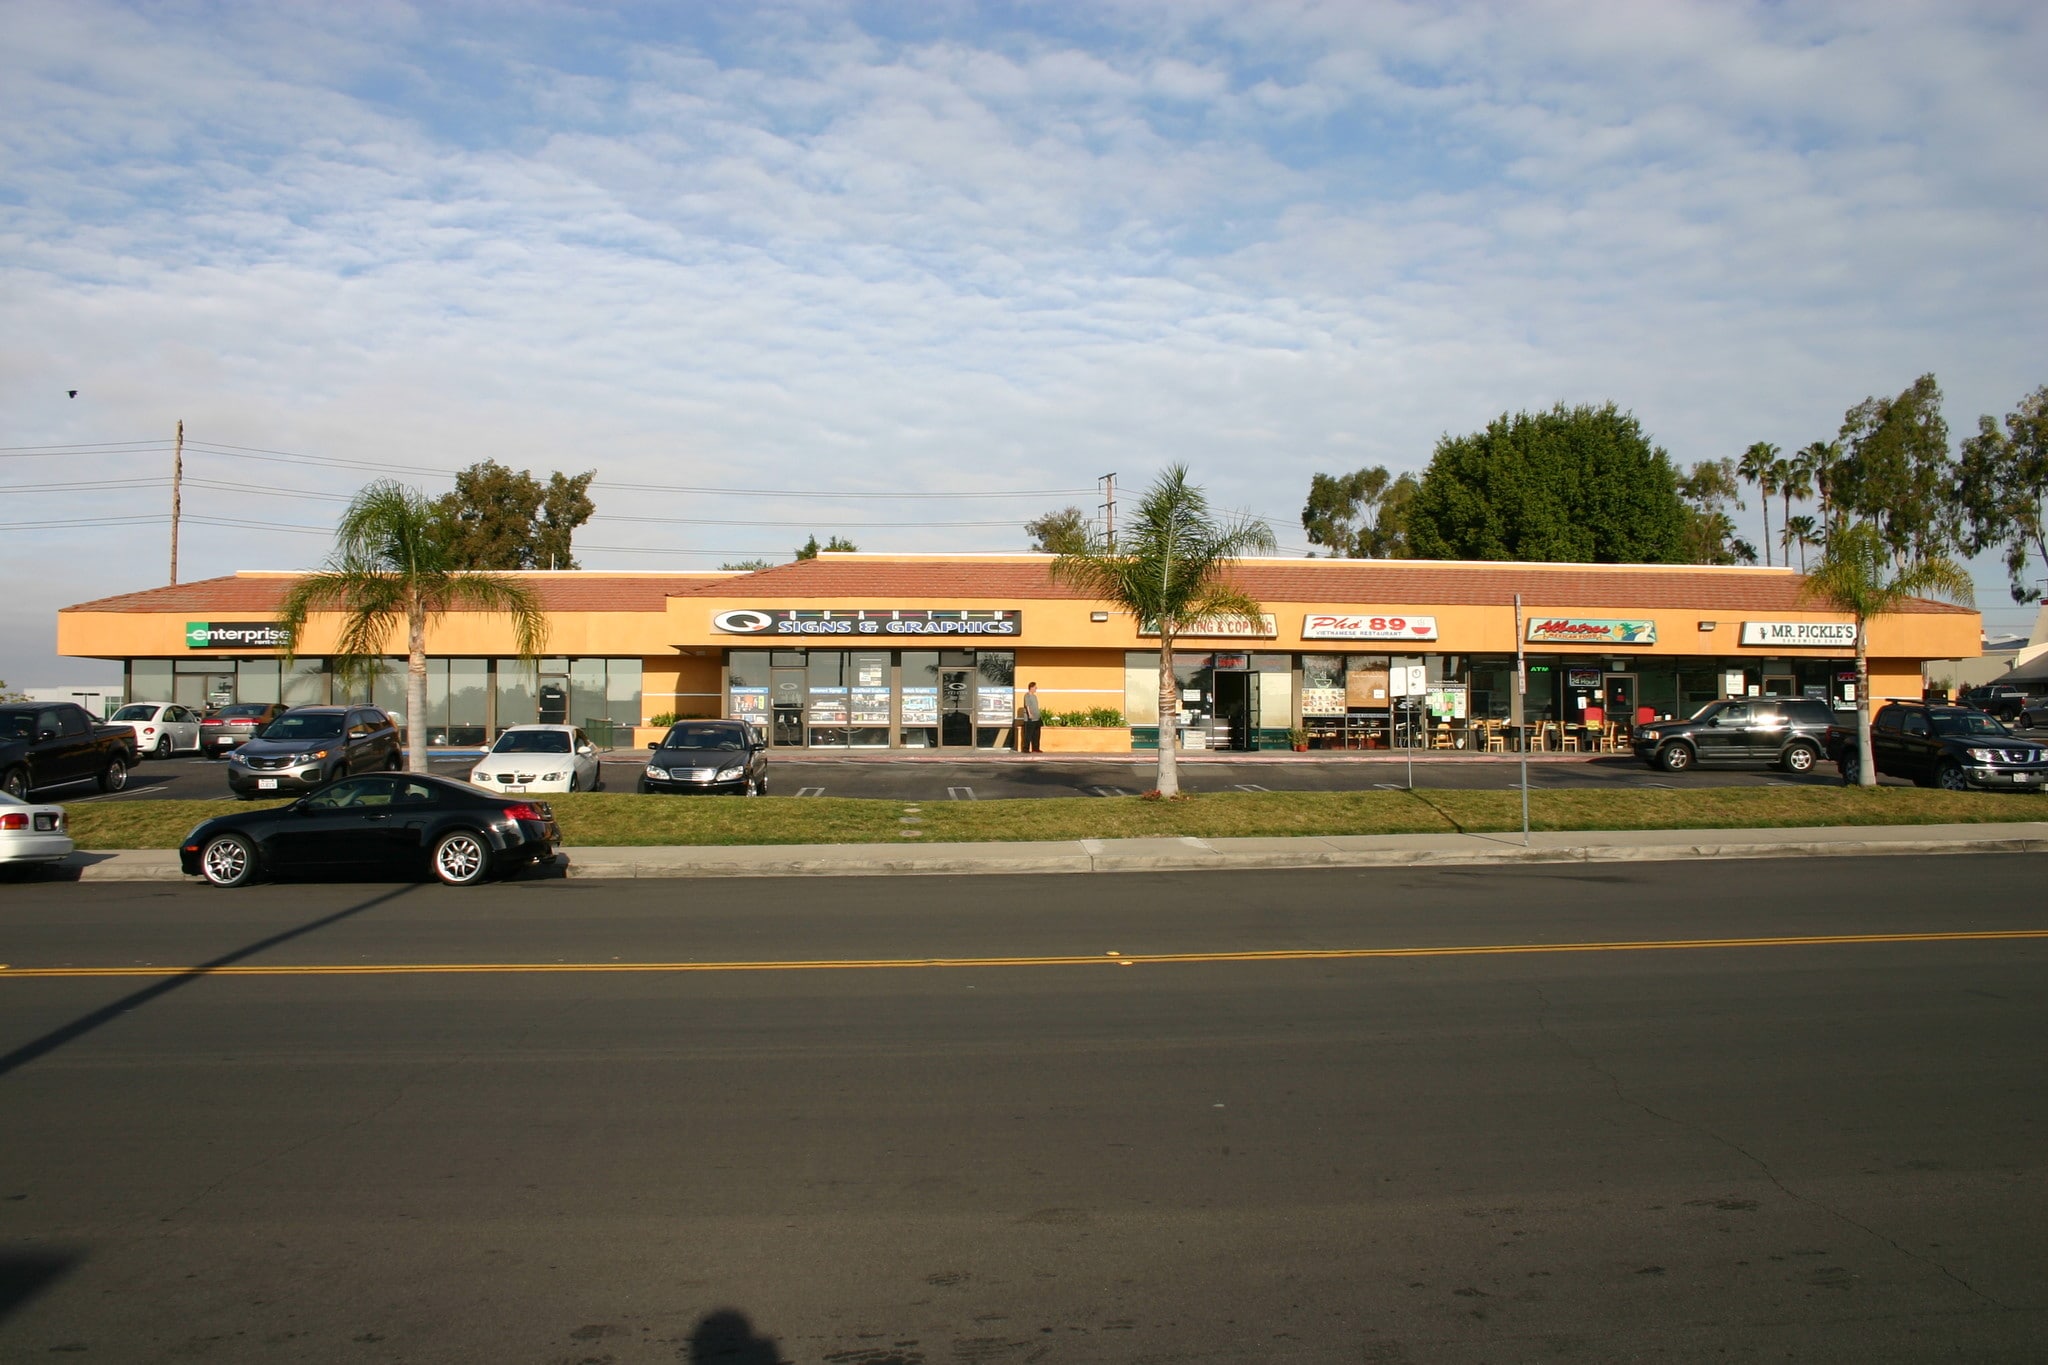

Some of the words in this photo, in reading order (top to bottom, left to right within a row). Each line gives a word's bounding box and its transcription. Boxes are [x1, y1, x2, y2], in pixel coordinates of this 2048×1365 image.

[788, 610, 1004, 621] QUANTUM
[778, 620, 852, 633] SIGNS
[859, 621, 879, 633] &
[886, 620, 1014, 634] GRAPHICS
[1217, 621, 1225, 633] &
[1369, 617, 1406, 631] 89
[1771, 624, 1796, 638] MR.
